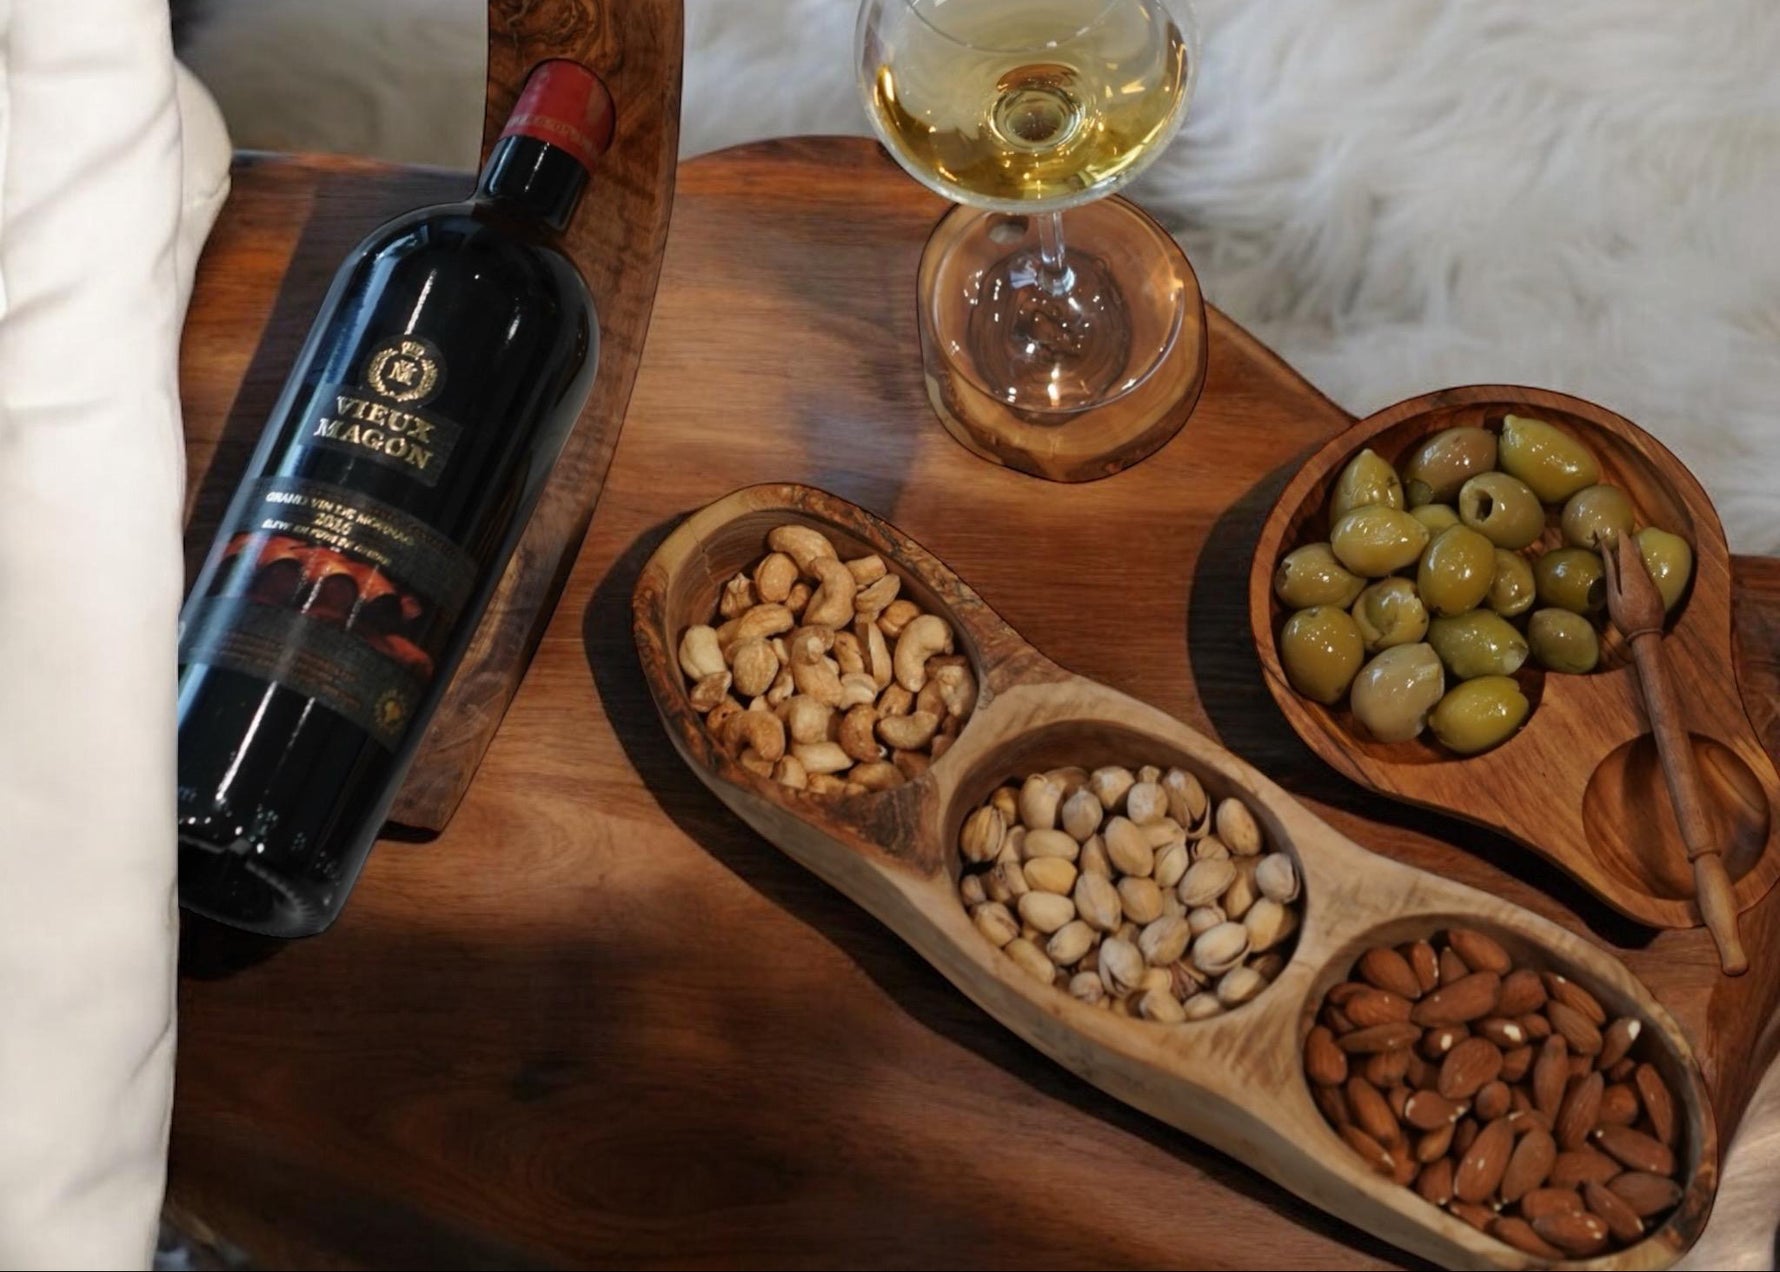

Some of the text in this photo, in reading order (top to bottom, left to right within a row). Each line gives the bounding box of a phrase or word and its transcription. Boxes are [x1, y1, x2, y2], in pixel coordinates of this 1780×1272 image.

[313, 418, 433, 469] MAGON
[337, 396, 435, 444] VIEUX
[311, 498, 333, 511] VIN
